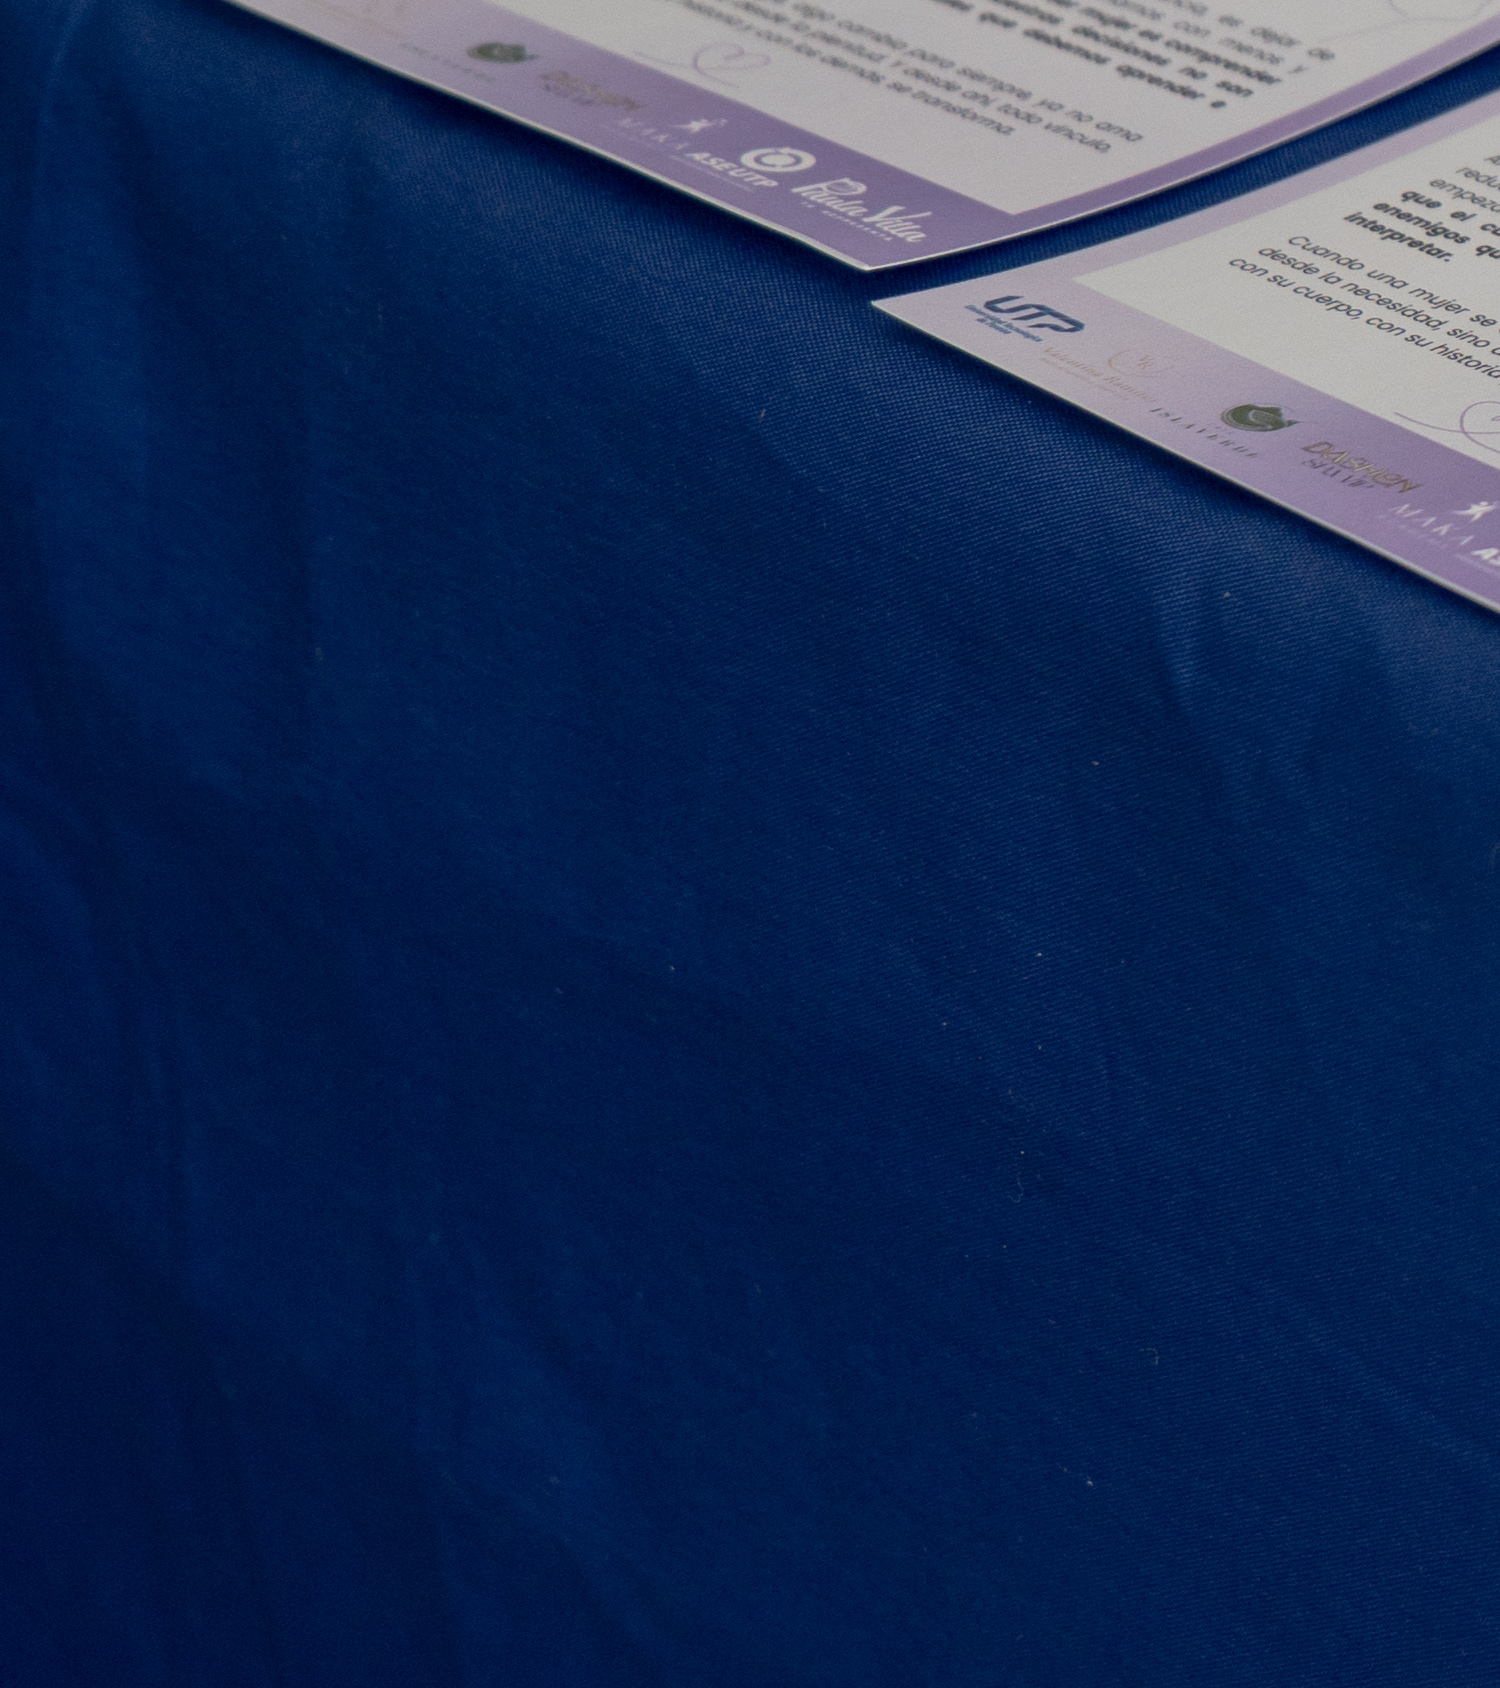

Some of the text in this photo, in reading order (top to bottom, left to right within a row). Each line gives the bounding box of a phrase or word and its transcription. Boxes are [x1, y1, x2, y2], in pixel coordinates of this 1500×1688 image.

[686, 152, 779, 188] ASEUTP
[790, 177, 869, 218] Paula
[862, 205, 933, 244] Villa
[1372, 202, 1471, 244] enemigos
[1400, 190, 1443, 210] que
[1449, 210, 1478, 223] el
[1343, 211, 1454, 263] interpretar.
[1228, 258, 1270, 277] con
[1266, 274, 1296, 288] su
[1292, 286, 1364, 320] cuerpo,
[1364, 317, 1407, 337] con
[1403, 334, 1434, 348] su
[1257, 247, 1320, 275] desde
[1317, 271, 1344, 285] la
[1340, 282, 1449, 331] necesidad,
[1445, 328, 1491, 348] sino
[1287, 235, 1366, 271] Cuando
[1365, 269, 1410, 290] una
[1408, 288, 1471, 315] mujer
[1468, 314, 1498, 328] se
[983, 295, 1086, 334] UTP
